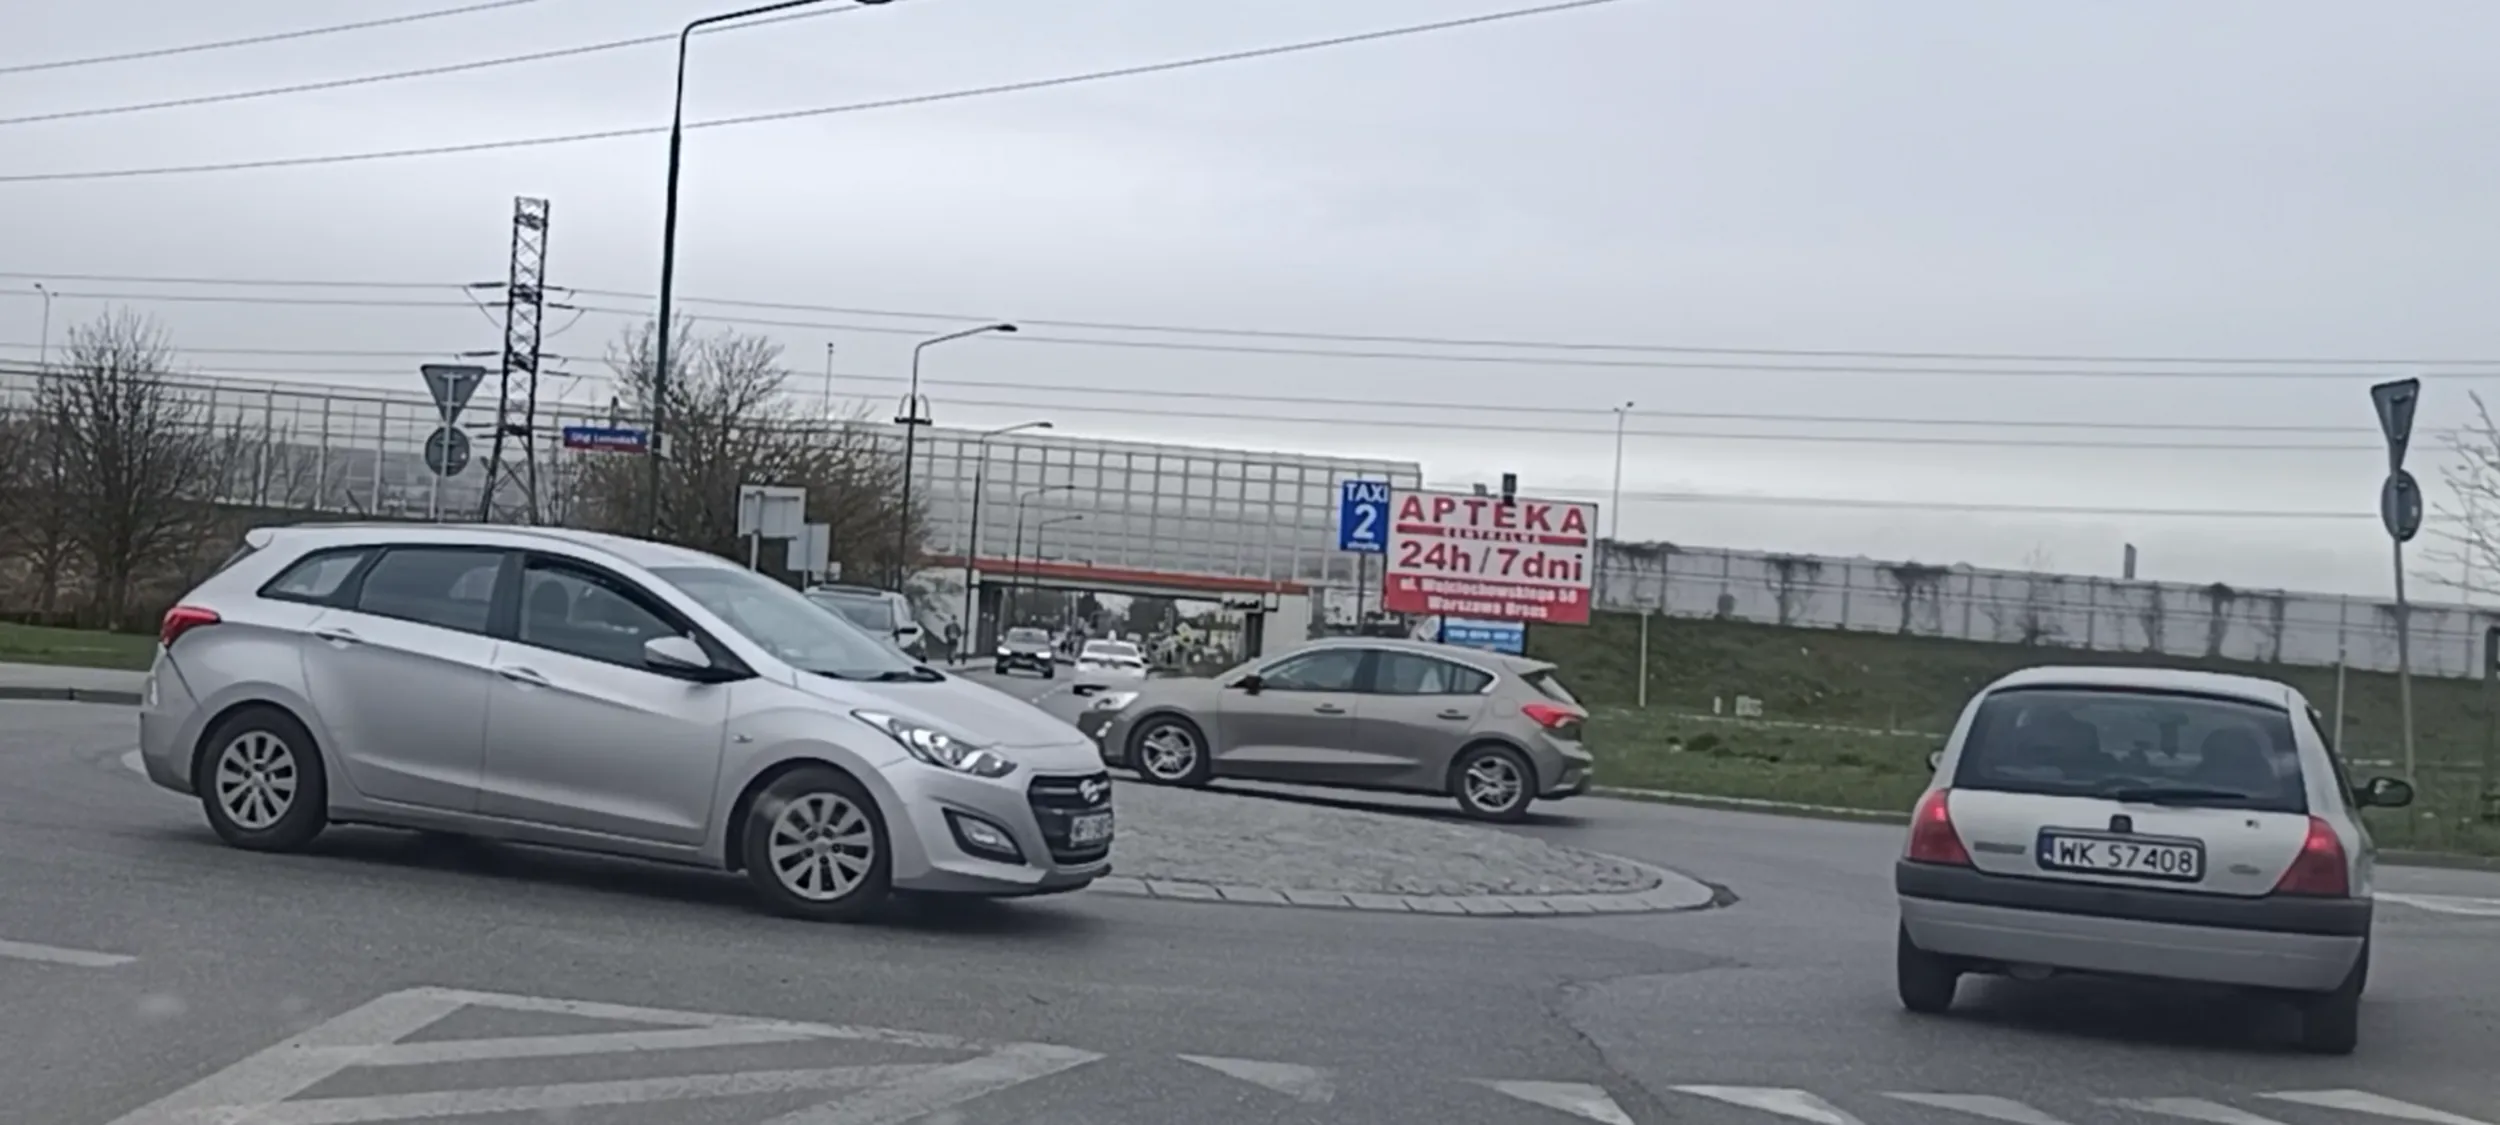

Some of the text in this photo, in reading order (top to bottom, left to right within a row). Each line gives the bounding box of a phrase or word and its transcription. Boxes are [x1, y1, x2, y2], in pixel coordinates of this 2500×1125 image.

[1346, 483, 1388, 503] TAXI
[1352, 503, 1377, 540] 2
[1399, 495, 1587, 534] APTEKA
[1428, 595, 1501, 615] Warszawa
[2059, 840, 2096, 867] WK
[2107, 844, 2193, 874] 57408
